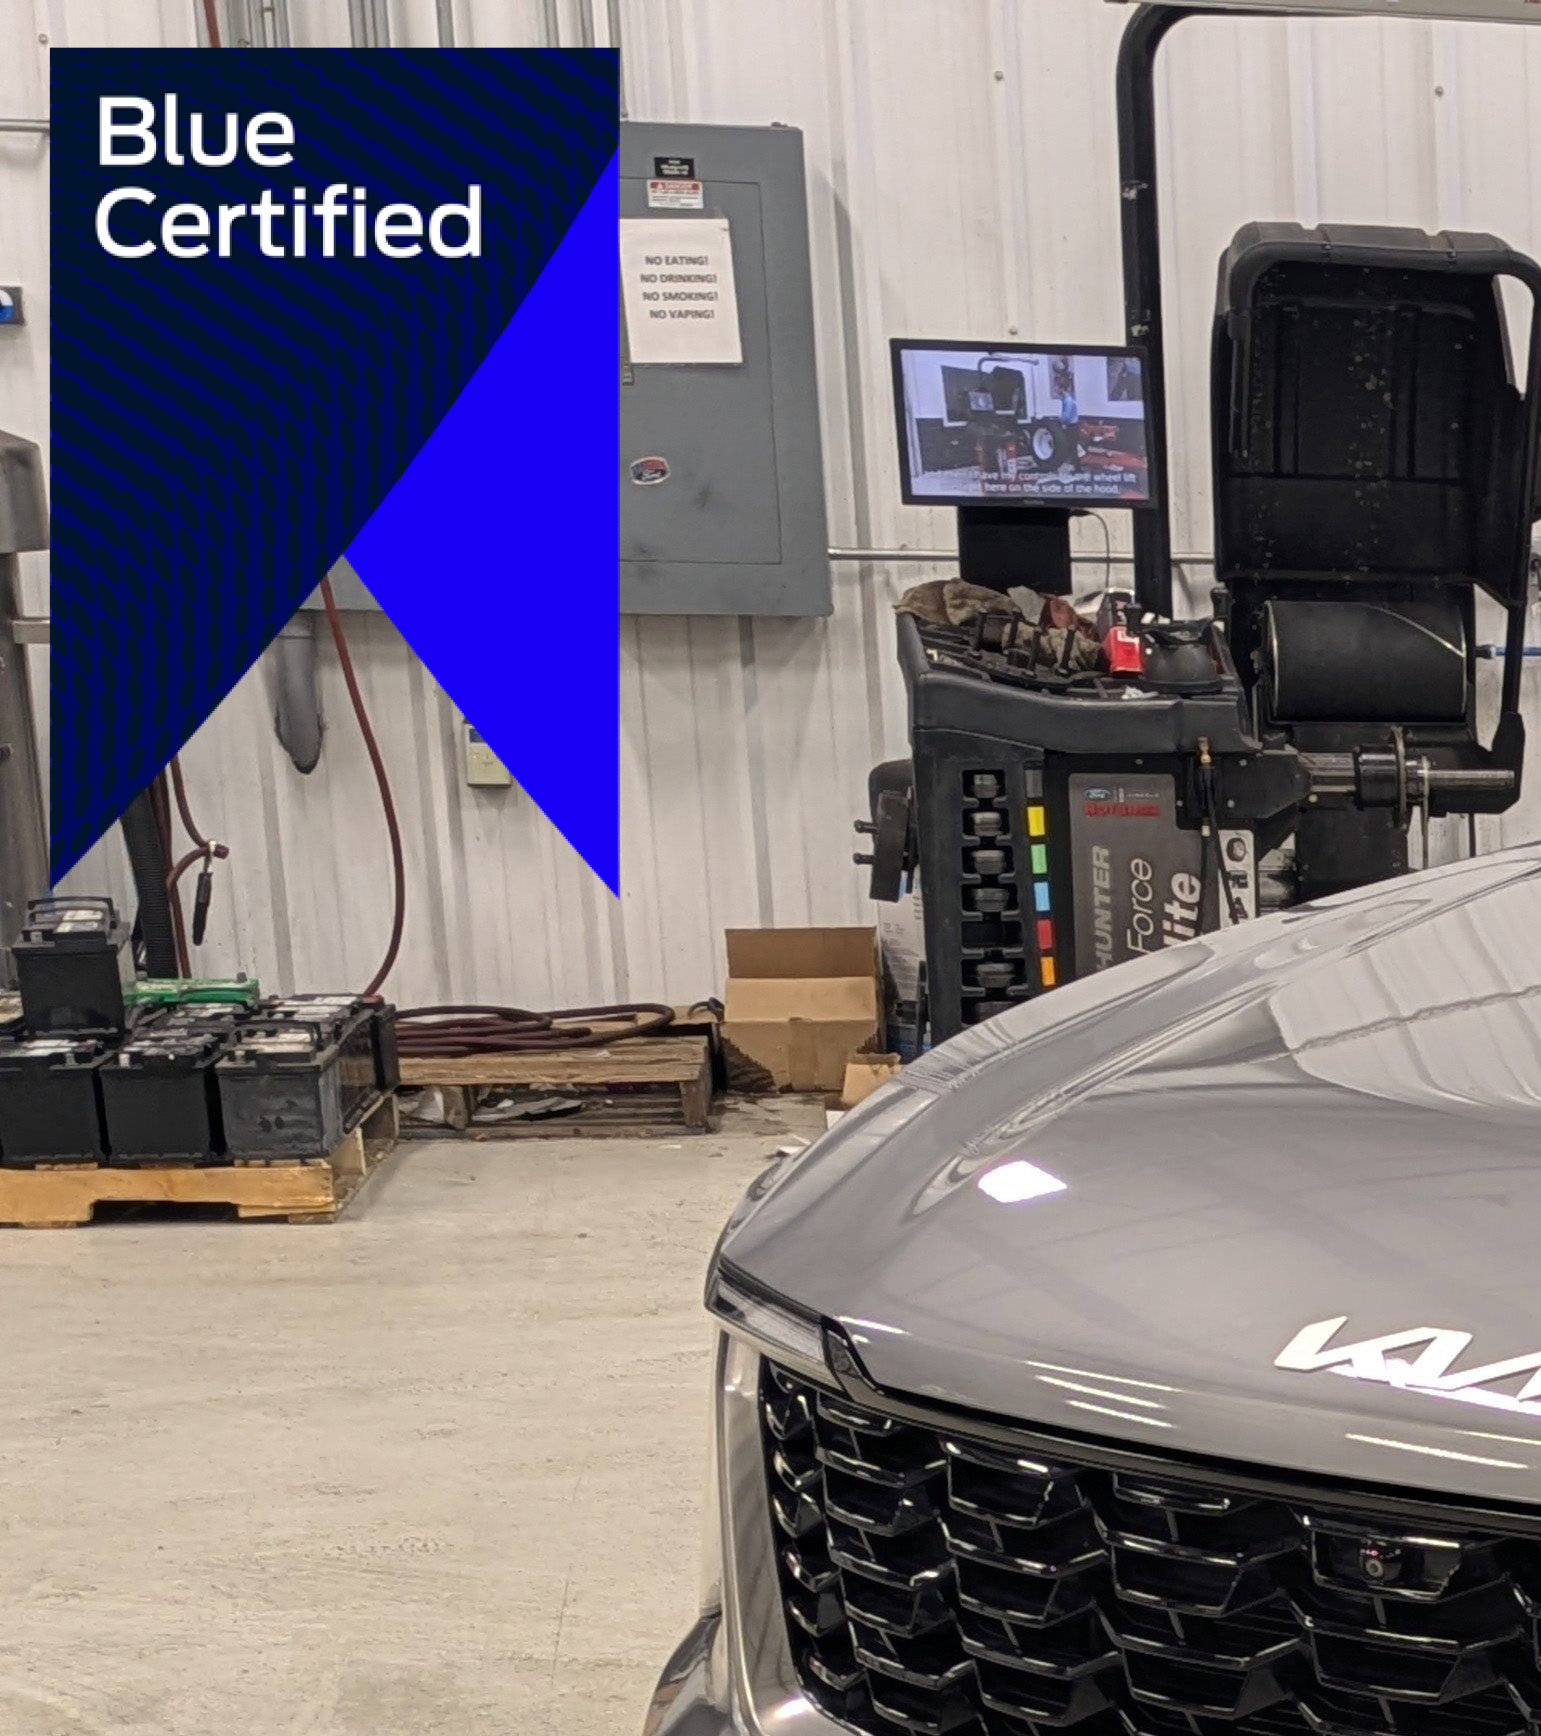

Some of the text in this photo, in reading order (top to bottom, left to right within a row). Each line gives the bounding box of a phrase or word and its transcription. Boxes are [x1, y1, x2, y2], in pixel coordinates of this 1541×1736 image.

[645, 255, 709, 266] NO EATING!
[640, 273, 718, 283] NO DRINKING!
[642, 291, 719, 302] NO SMOKING!
[649, 309, 715, 320] NO VAPING!
[1091, 845, 1114, 970] HUNTER
[1126, 857, 1155, 954] Force
[1162, 872, 1202, 947] lite
